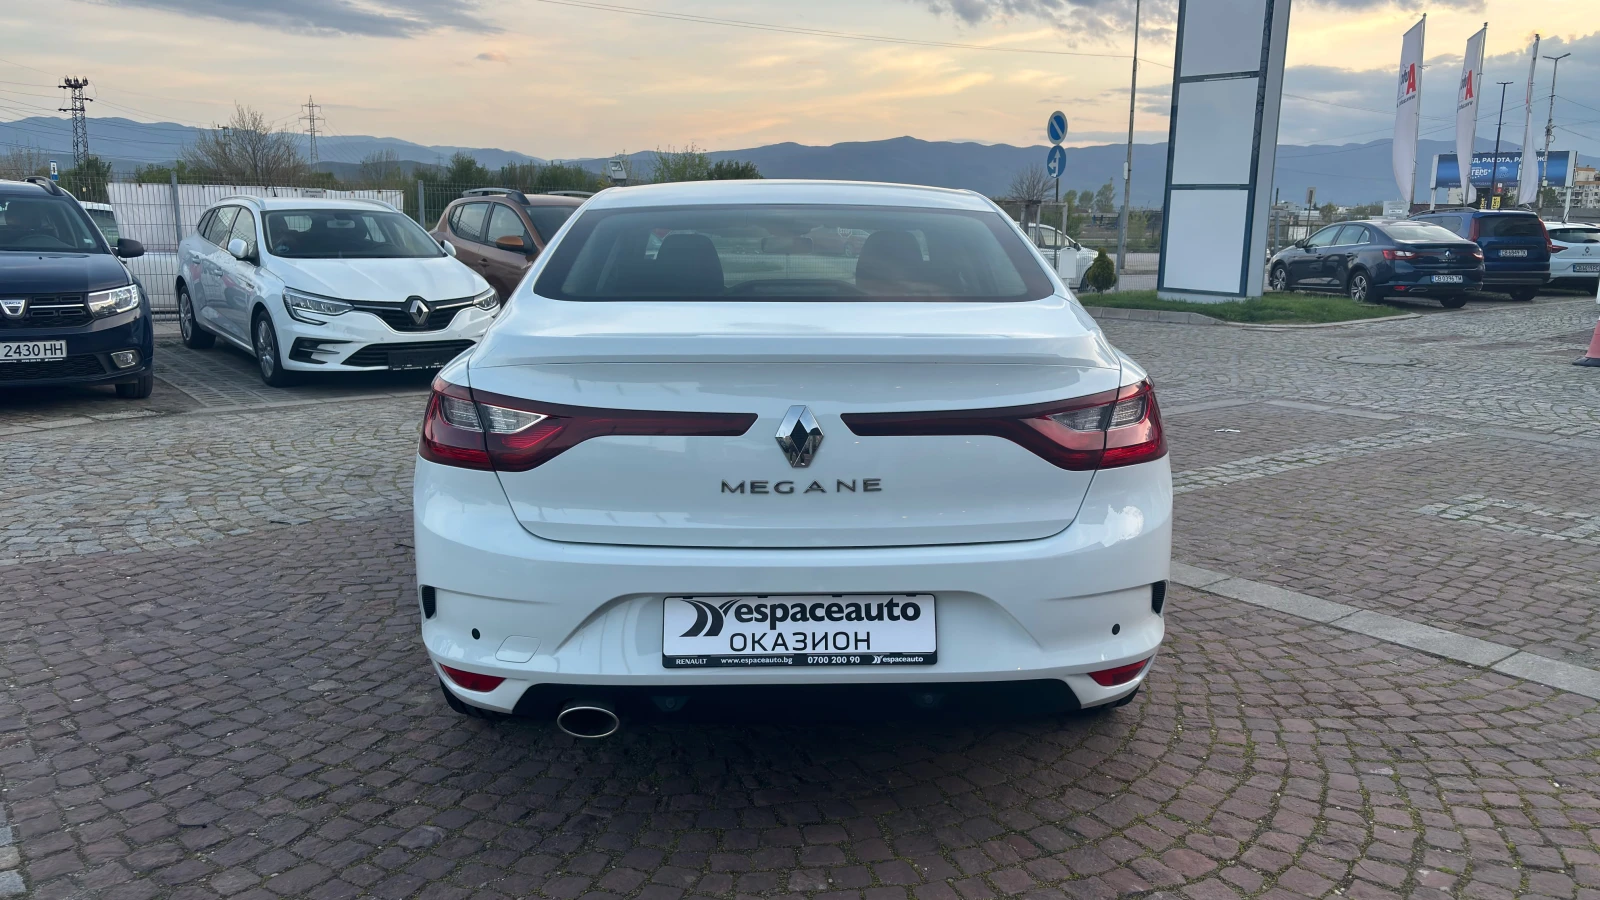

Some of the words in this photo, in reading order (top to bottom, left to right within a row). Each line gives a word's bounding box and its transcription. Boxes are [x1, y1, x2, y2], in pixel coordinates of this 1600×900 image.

[3, 343, 41, 357] 2430
[43, 342, 63, 356] HH
[720, 478, 883, 494] MEGANE
[734, 597, 922, 631] espaceauto
[729, 631, 871, 652] ОКАЗИОН
[720, 656, 793, 665] www.espaceauto.bg
[807, 656, 829, 664] 0700
[831, 656, 847, 664] 200
[849, 655, 861, 664] 90
[882, 655, 924, 663] espaceauto
